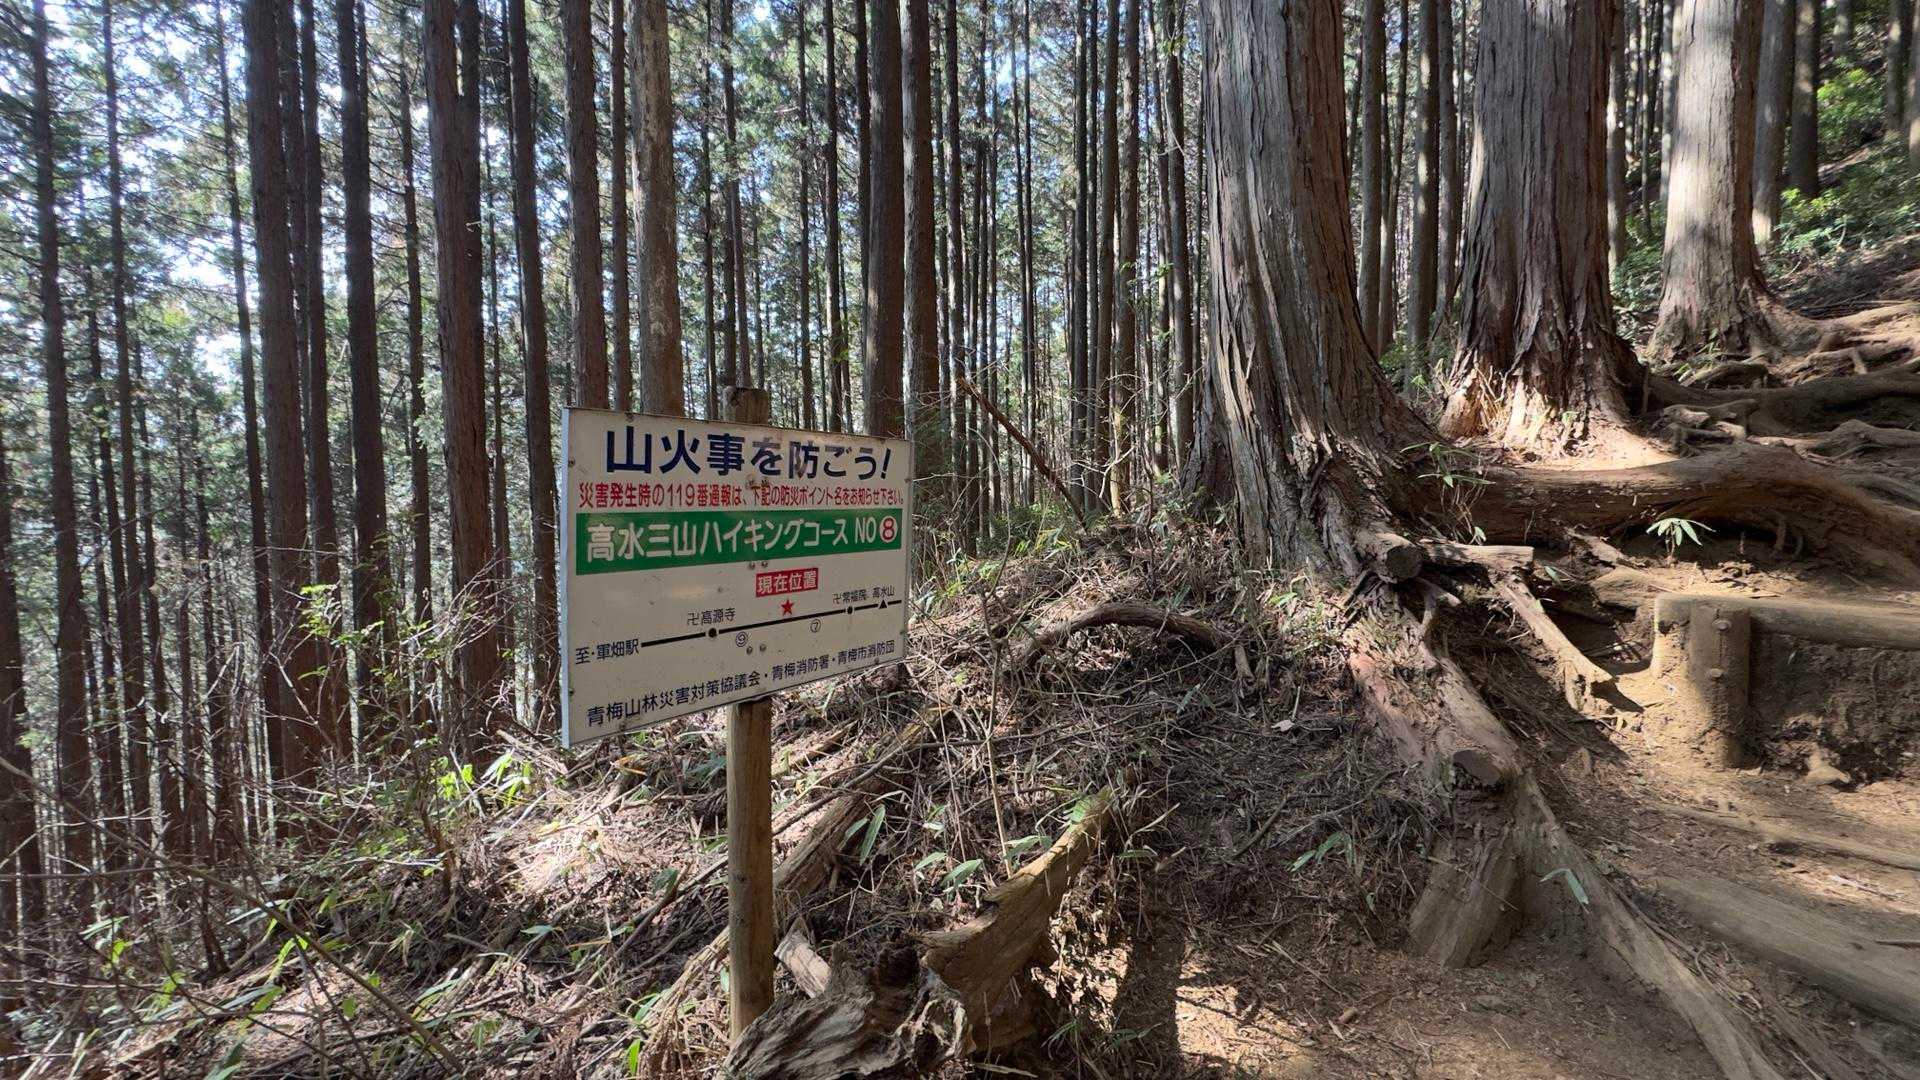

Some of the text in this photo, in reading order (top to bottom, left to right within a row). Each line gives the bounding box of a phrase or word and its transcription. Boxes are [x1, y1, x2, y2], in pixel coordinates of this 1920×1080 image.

[587, 518, 849, 563] 高水三山ハイキングコース
[757, 571, 817, 595] 現在位置
